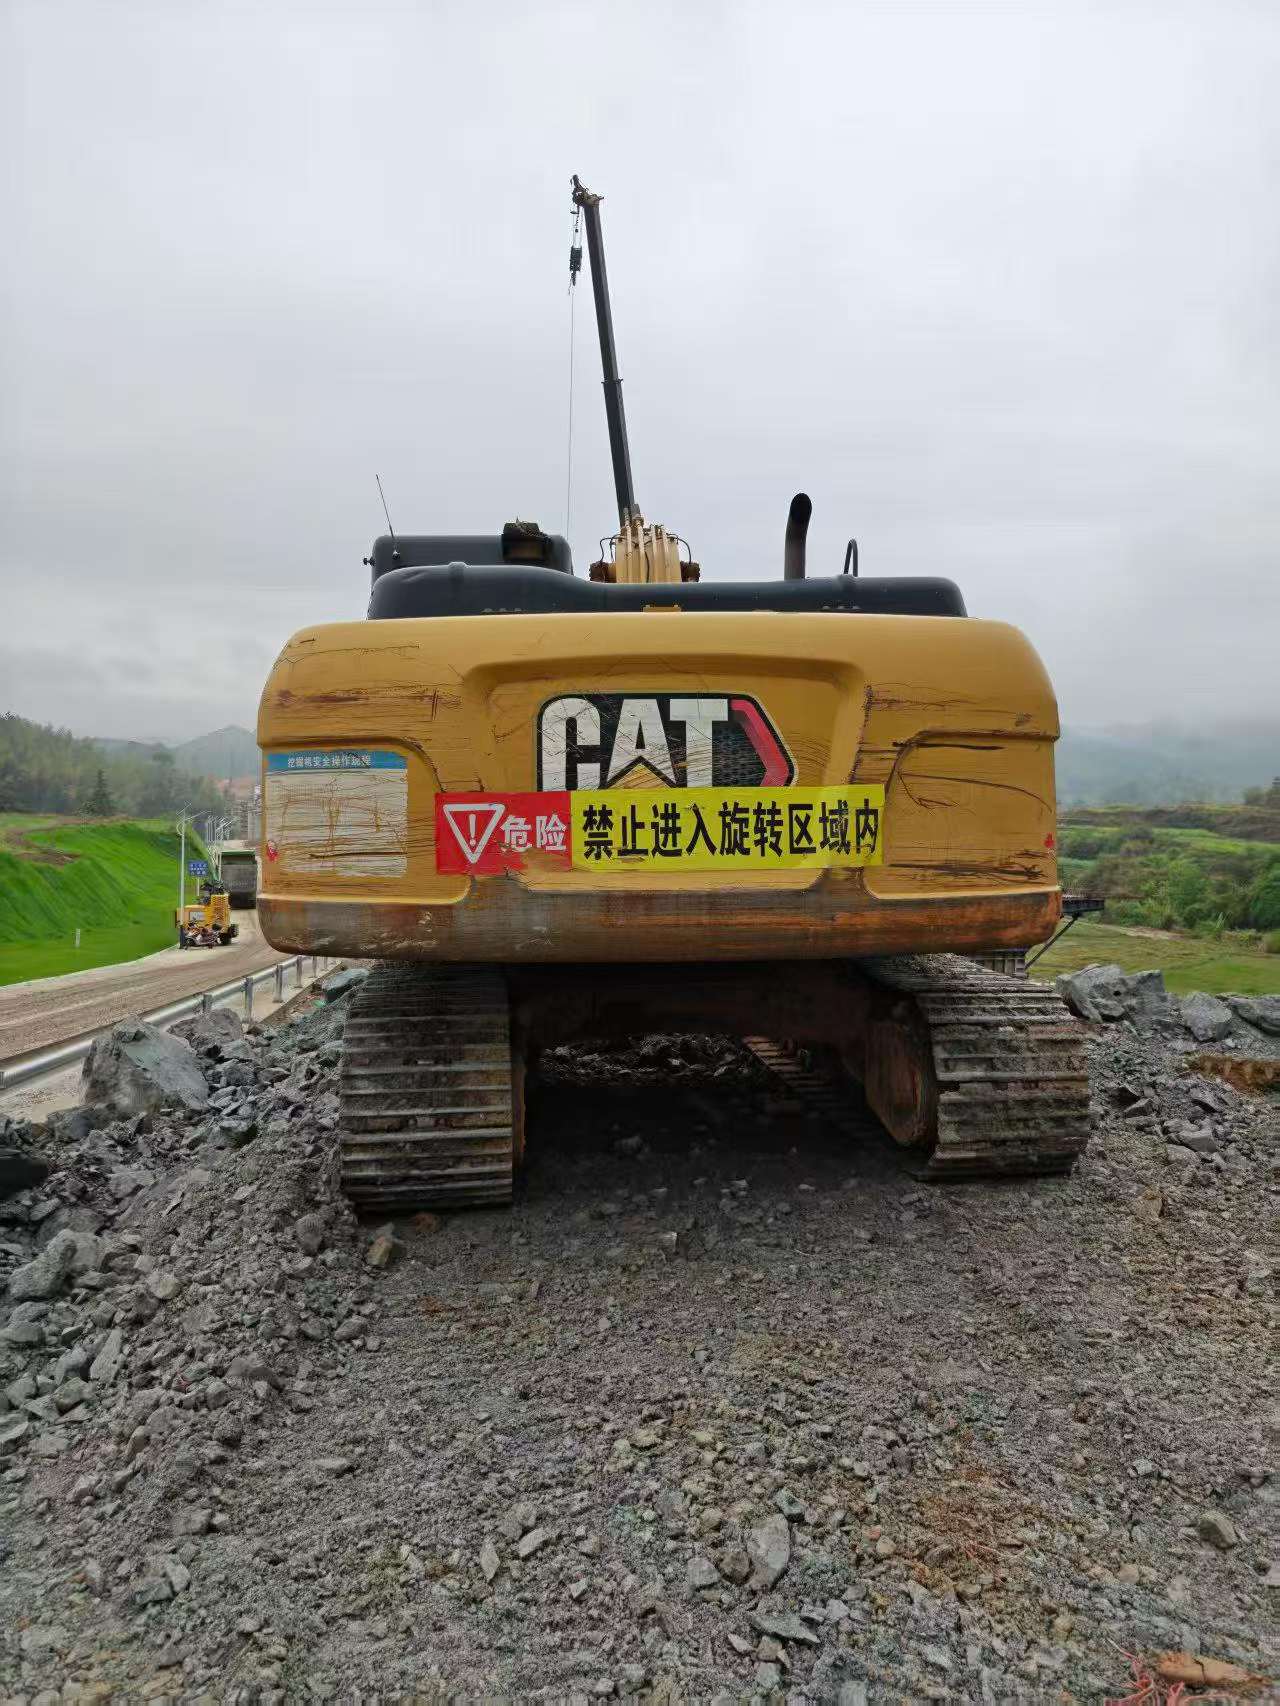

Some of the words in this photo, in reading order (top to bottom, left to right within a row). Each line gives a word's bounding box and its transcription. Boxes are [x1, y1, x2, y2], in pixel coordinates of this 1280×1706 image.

[541, 698, 729, 792] CAT
[500, 814, 567, 853] 危险
[582, 798, 879, 860] 禁止进入旋转区域内
